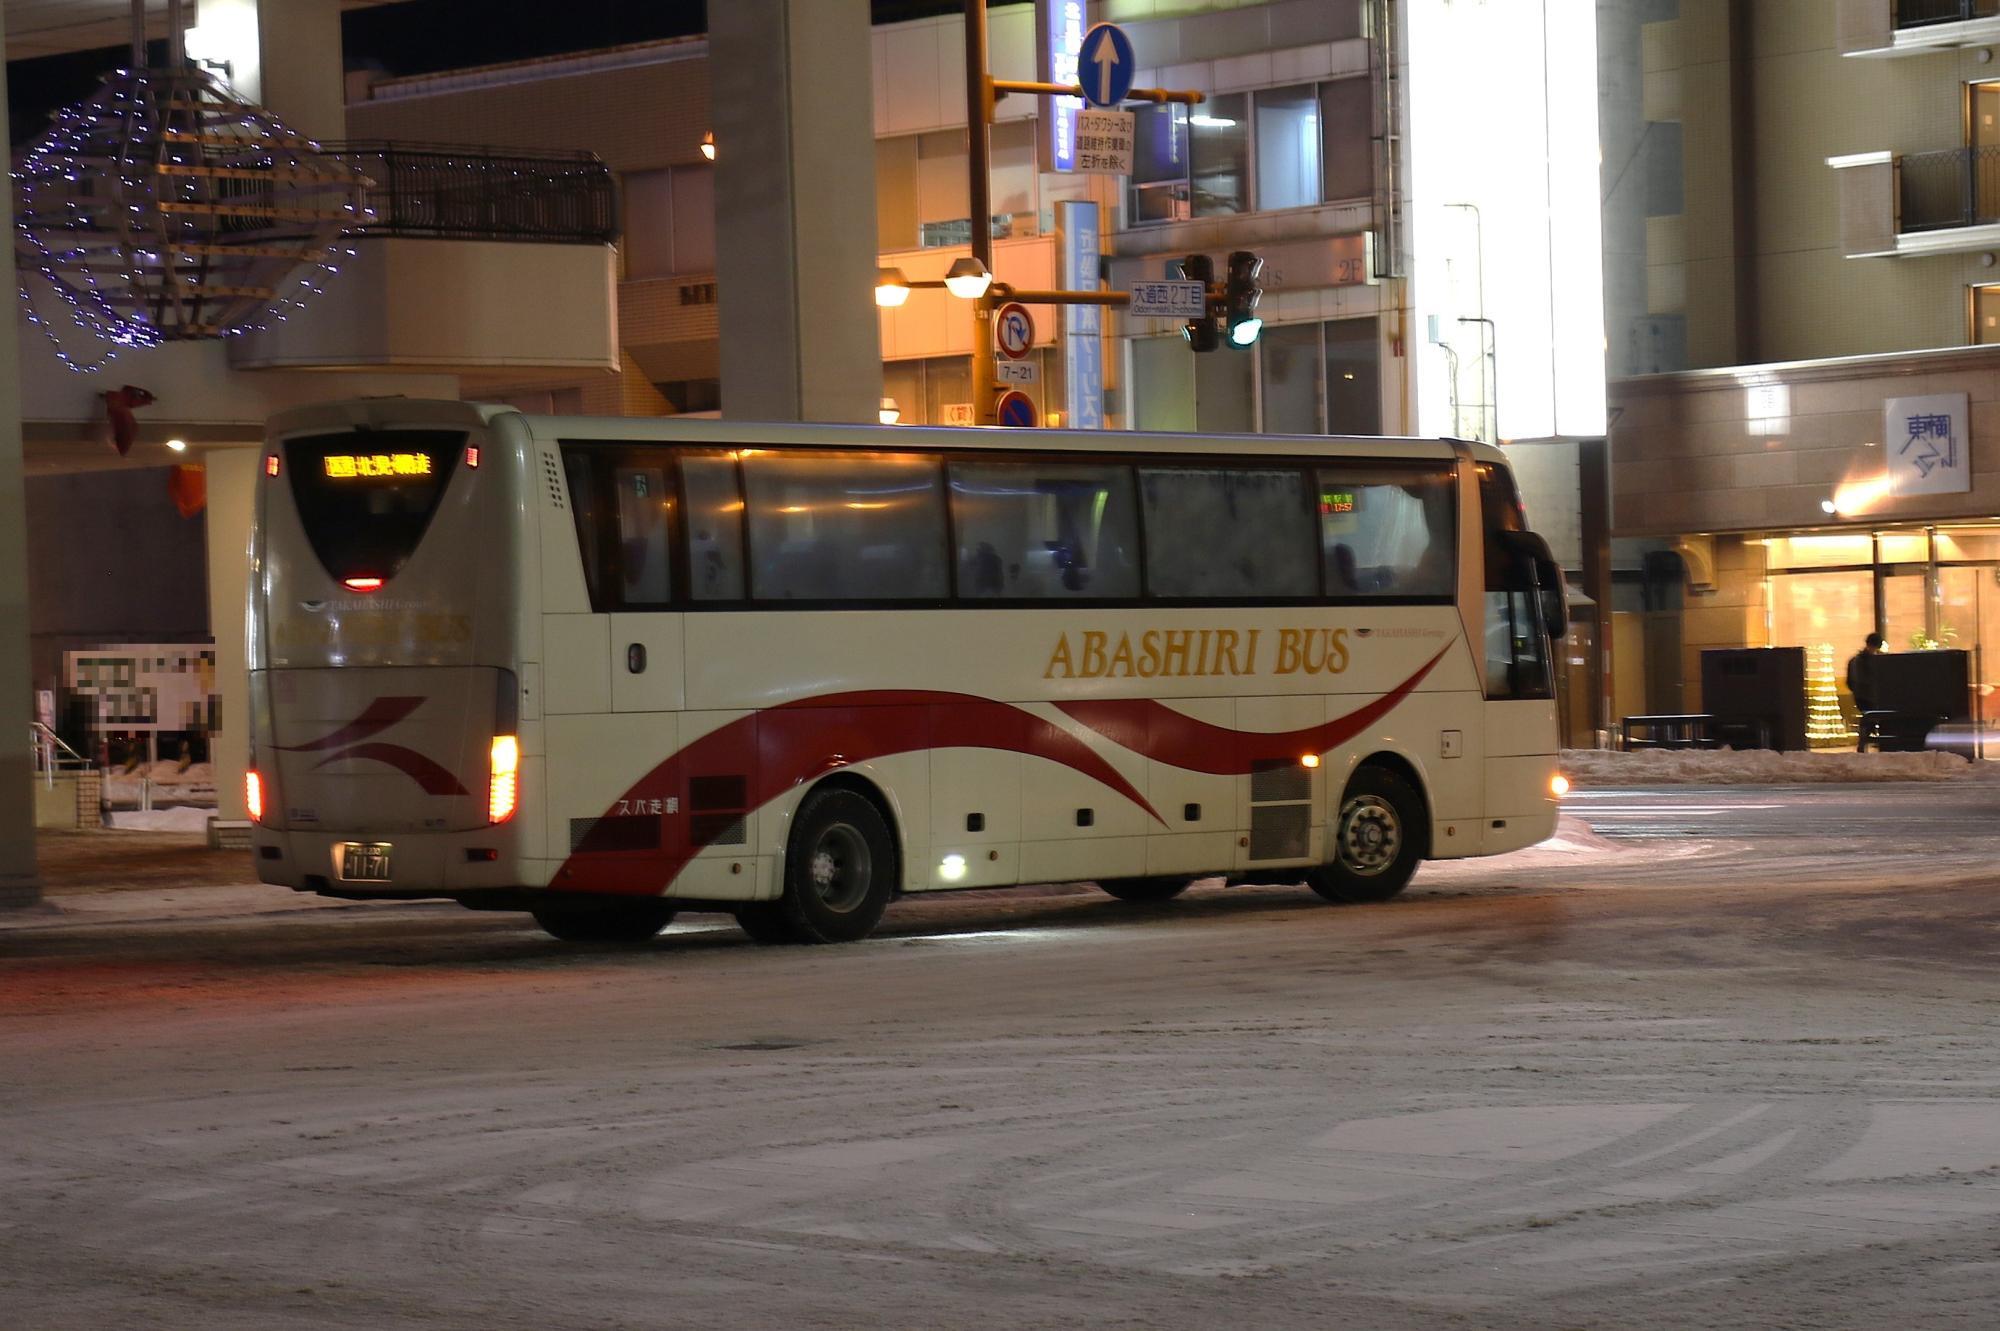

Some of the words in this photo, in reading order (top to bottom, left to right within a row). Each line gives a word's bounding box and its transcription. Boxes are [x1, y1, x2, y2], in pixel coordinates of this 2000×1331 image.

[1080, 154, 1126, 170] 左折を除く
[1133, 284, 1201, 305] 大通西2丁目
[1003, 365, 1033, 380] 7-21
[1043, 628, 1261, 679] ABASHIRI
[1272, 627, 1351, 675] BUS
